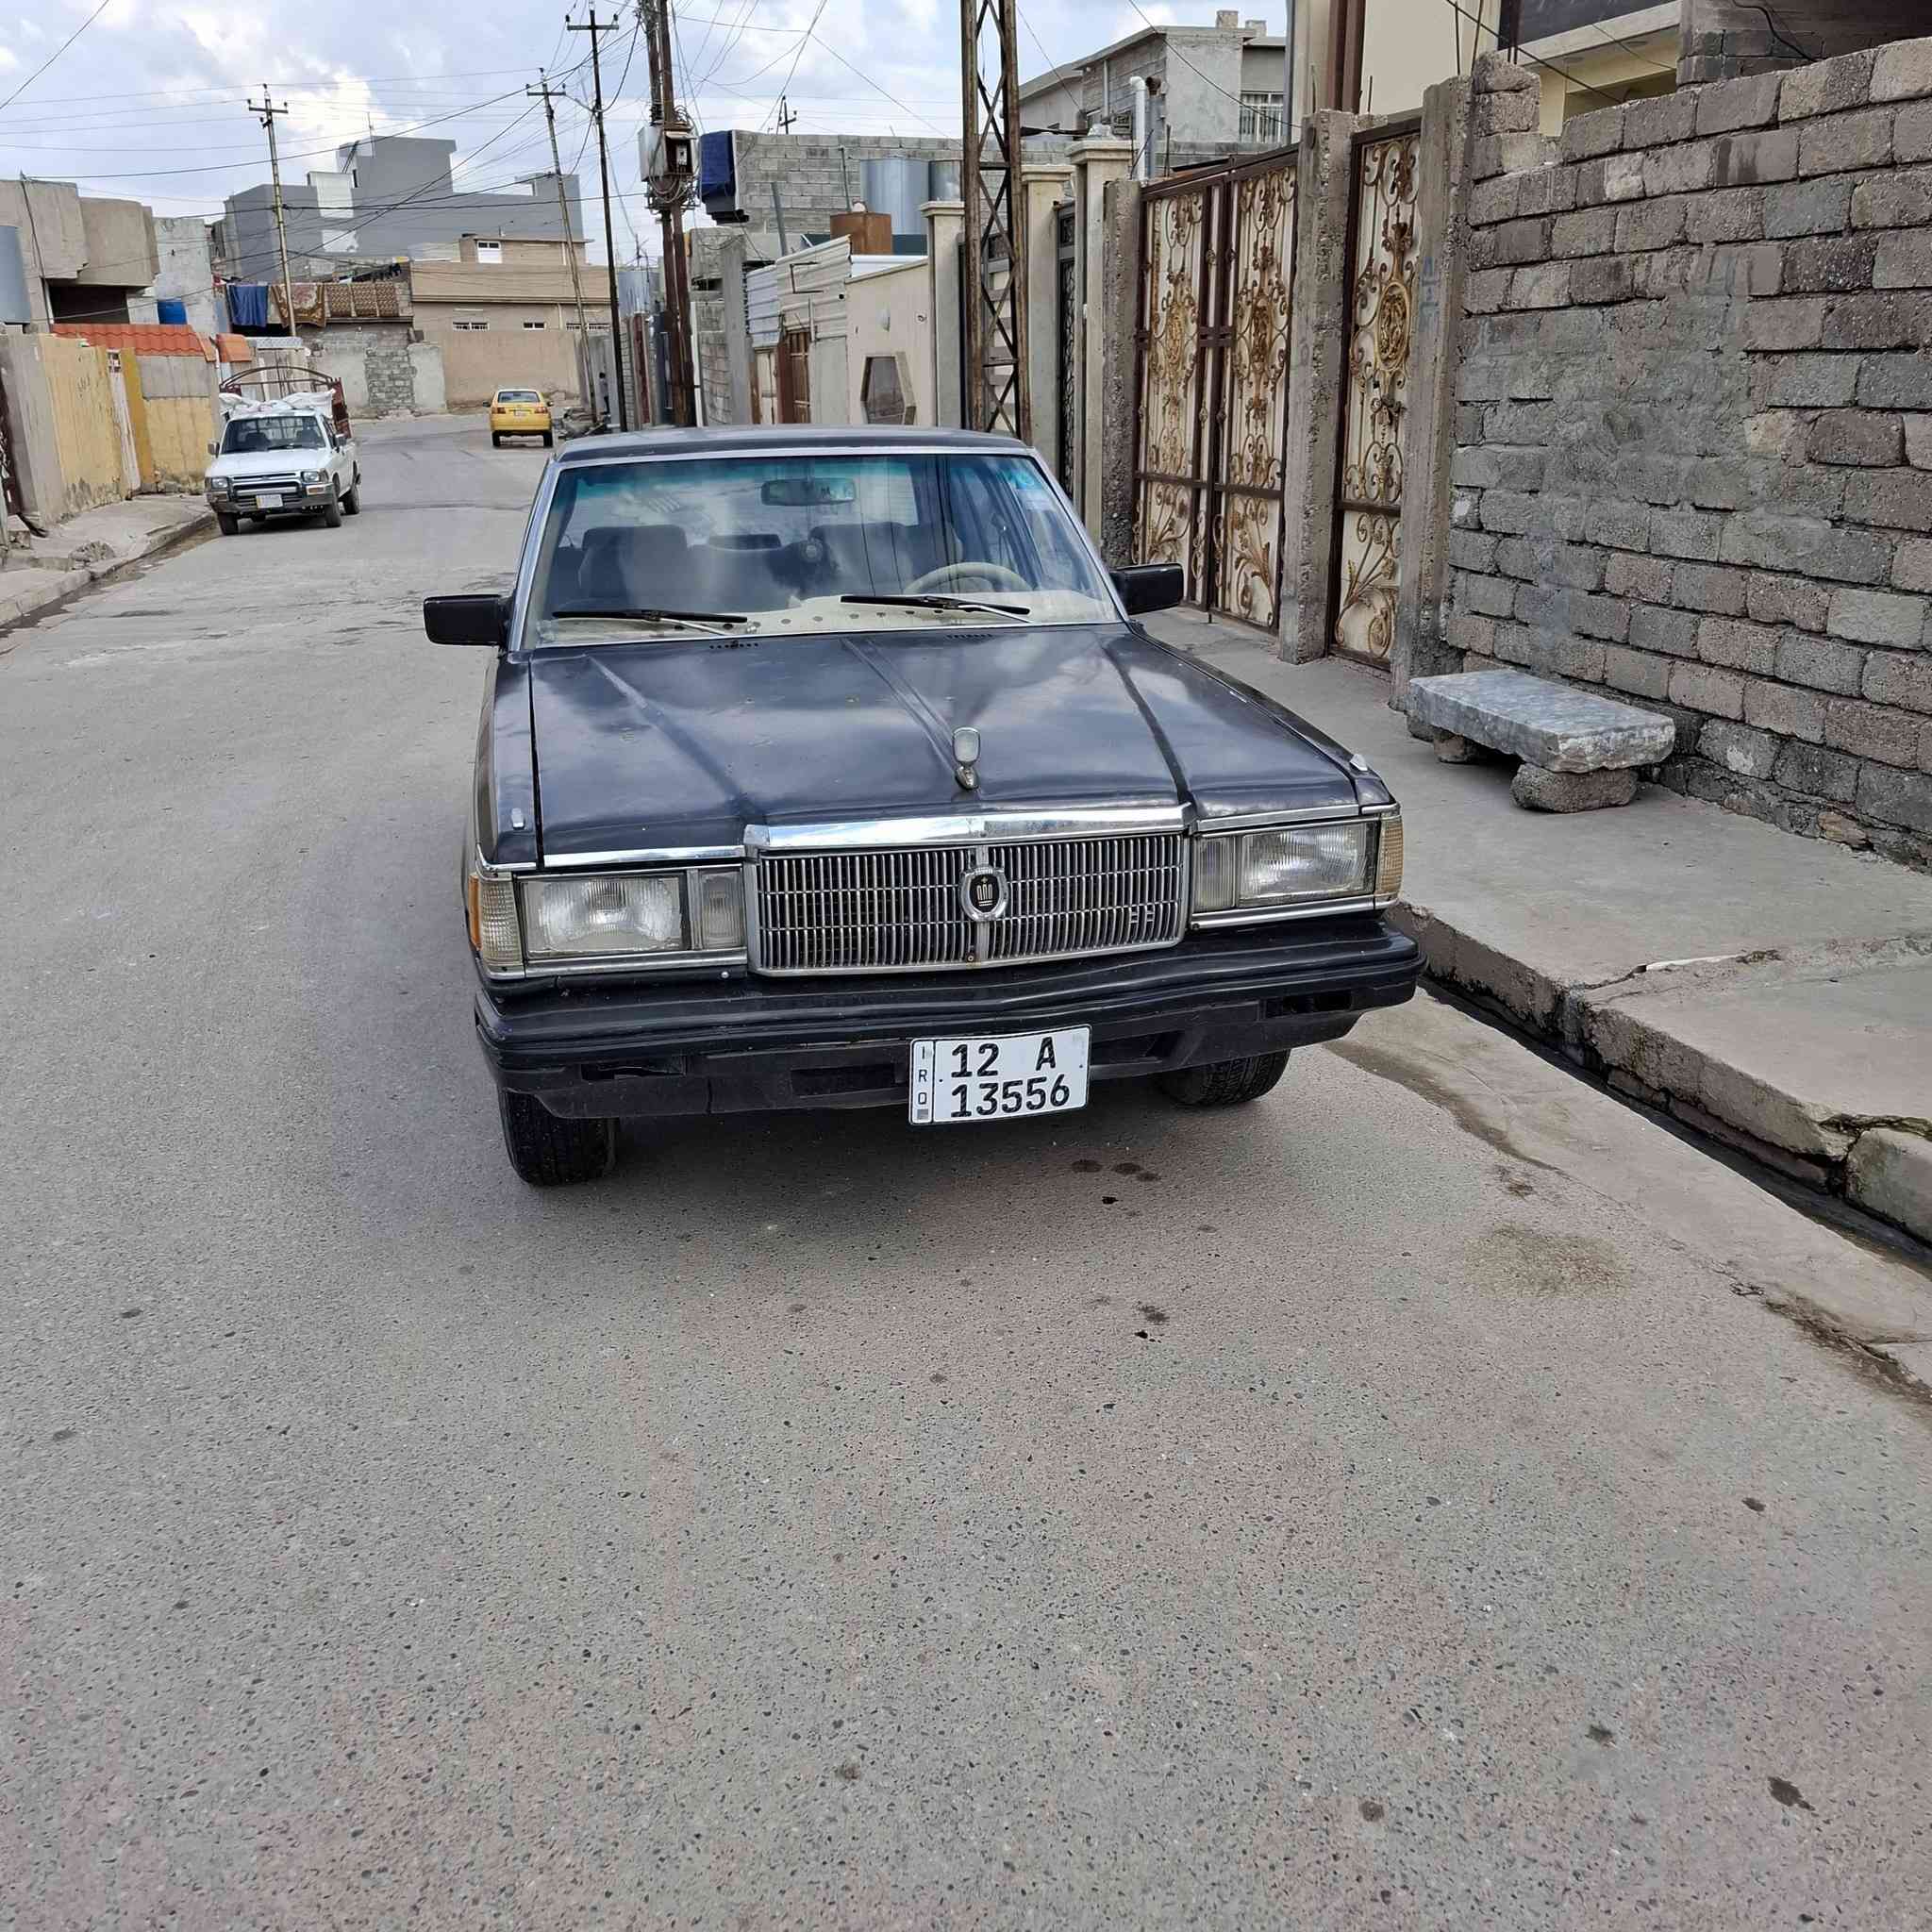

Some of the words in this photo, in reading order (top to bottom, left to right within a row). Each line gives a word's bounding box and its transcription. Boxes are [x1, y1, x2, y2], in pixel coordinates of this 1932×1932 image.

[951, 1042, 1000, 1078] 12
[1035, 1036, 1057, 1072] A
[951, 1074, 1070, 1118] 13556
